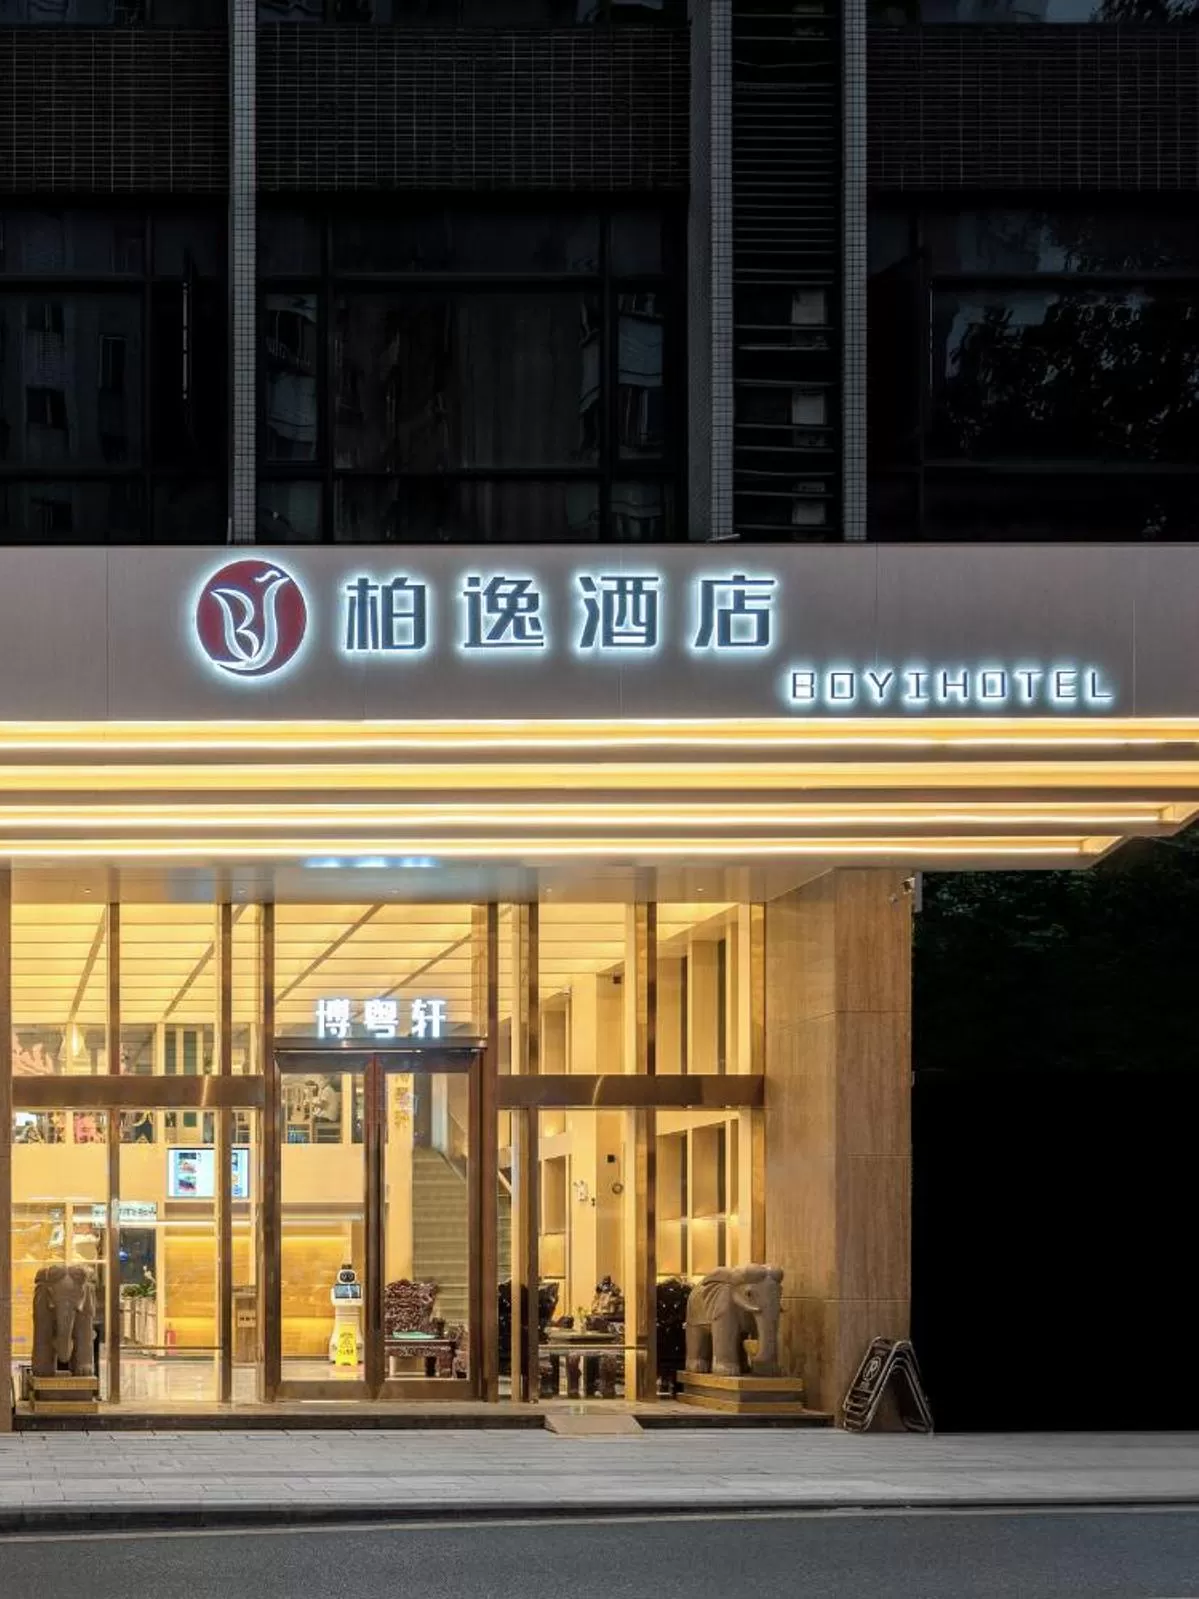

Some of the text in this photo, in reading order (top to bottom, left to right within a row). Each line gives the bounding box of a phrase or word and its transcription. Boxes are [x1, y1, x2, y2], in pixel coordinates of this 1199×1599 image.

[344, 574, 777, 652] 柏逸酒店
[789, 669, 1115, 701] BOYIHOTEL
